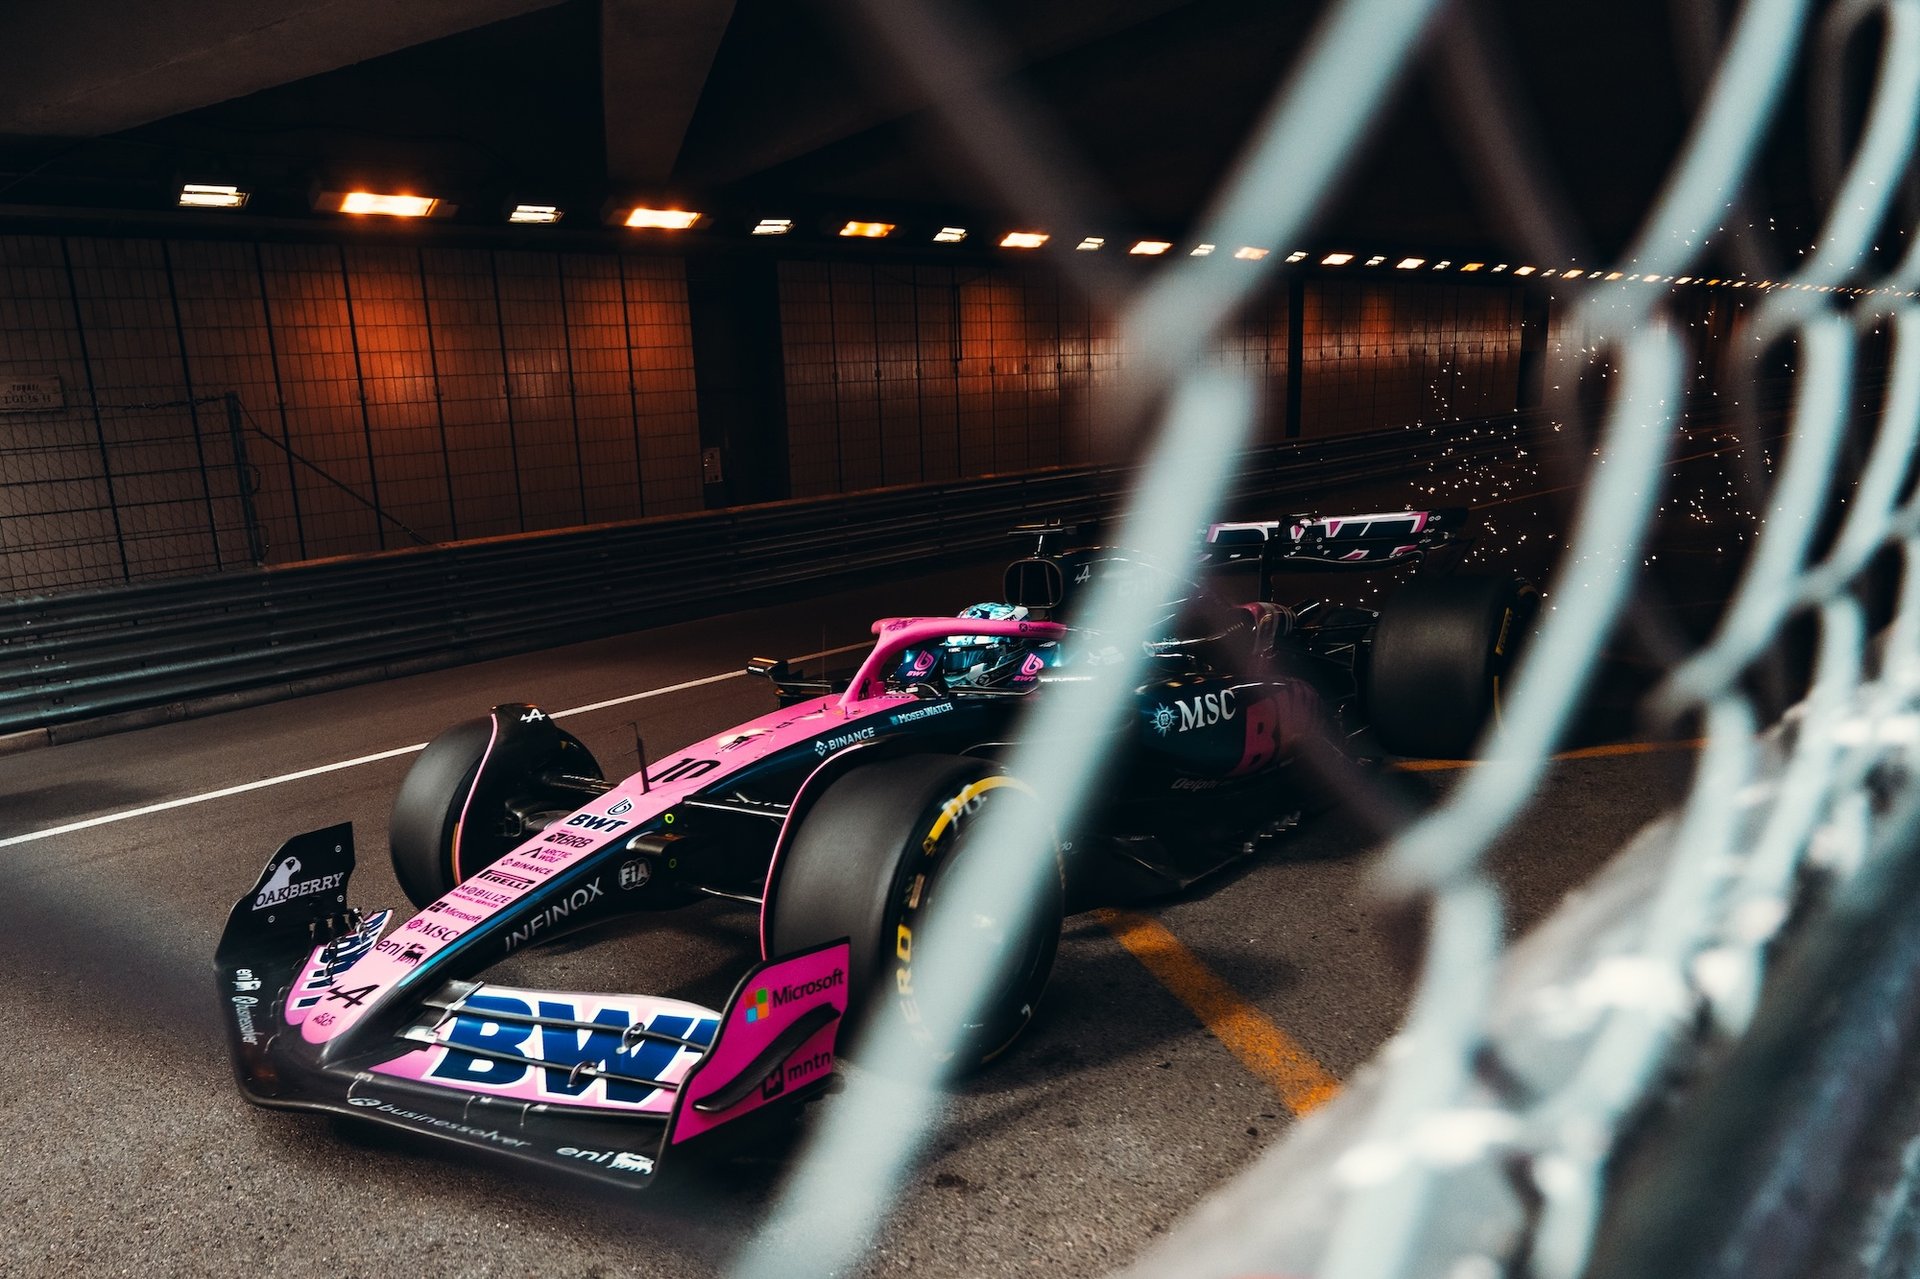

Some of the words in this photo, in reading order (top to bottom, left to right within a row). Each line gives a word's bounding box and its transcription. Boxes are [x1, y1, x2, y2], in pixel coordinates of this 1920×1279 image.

[906, 670, 927, 678] BWT
[1175, 689, 1237, 732] MSC
[827, 727, 875, 751] BINANCE
[648, 757, 721, 783] 10
[567, 813, 628, 833] BWT
[538, 854, 562, 864] WOLF
[543, 848, 573, 859] ARCTIC
[512, 860, 555, 876] BINANCE
[255, 872, 344, 907] OAKBERRY
[477, 869, 536, 891] PIRELLI
[457, 885, 511, 904] MOBILIZE
[443, 906, 482, 923] Microsoft
[505, 877, 603, 951] INFINOX
[419, 922, 459, 942] MSC
[376, 938, 400, 957] eni
[772, 967, 844, 1009] Microsoft
[788, 1049, 831, 1081] mntn
[376, 1103, 532, 1148] businessolver
[556, 1145, 614, 1164] eni
